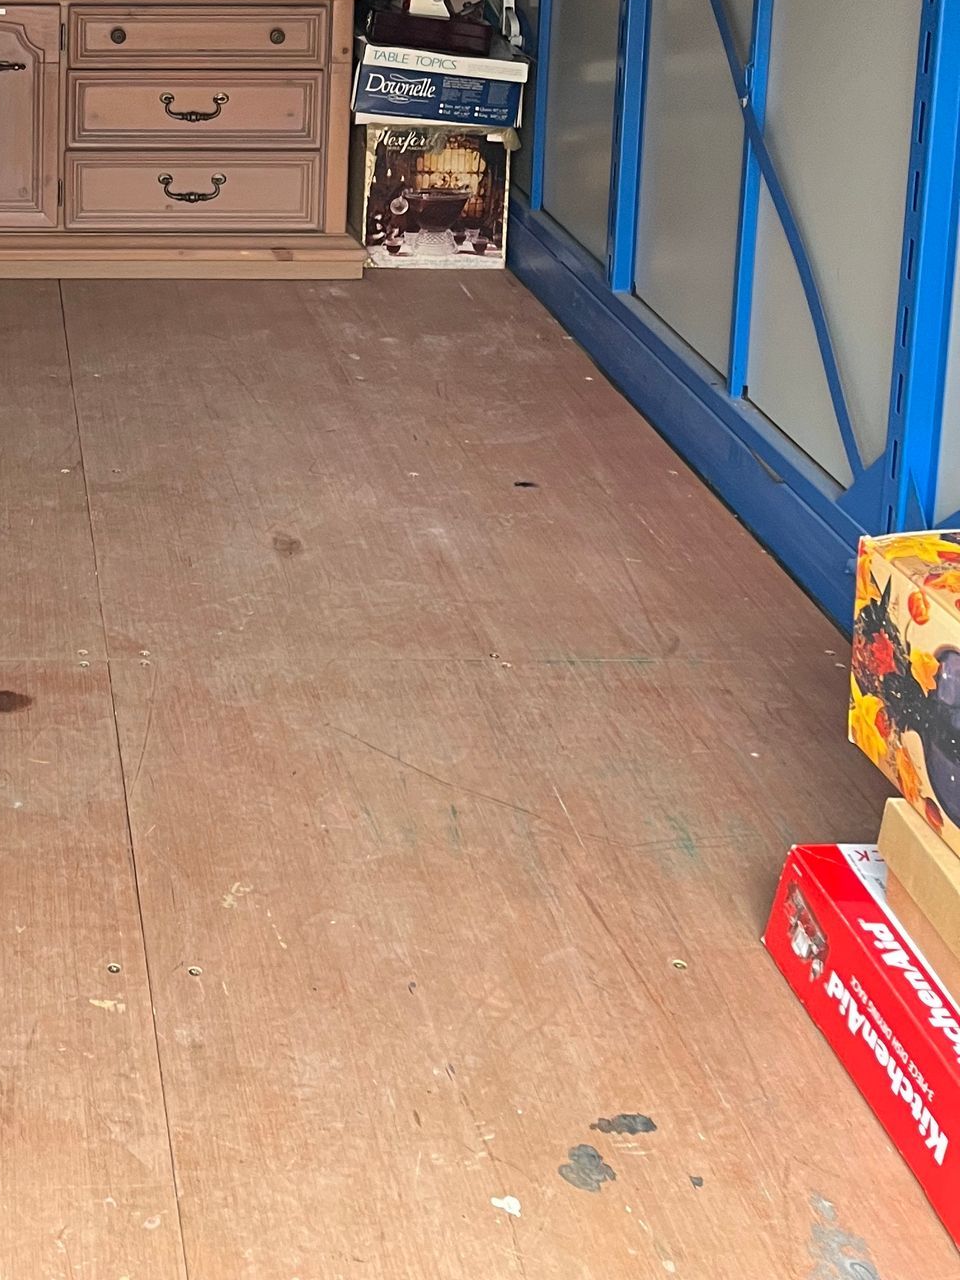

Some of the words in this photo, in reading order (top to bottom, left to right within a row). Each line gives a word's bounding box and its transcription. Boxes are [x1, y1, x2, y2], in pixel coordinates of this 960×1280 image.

[373, 50, 411, 64] TABLE
[416, 56, 457, 70] TOPICS
[365, 74, 436, 98] Downelle
[892, 1036, 908, 1064] DISH
[825, 970, 948, 1166] KitchenAid
